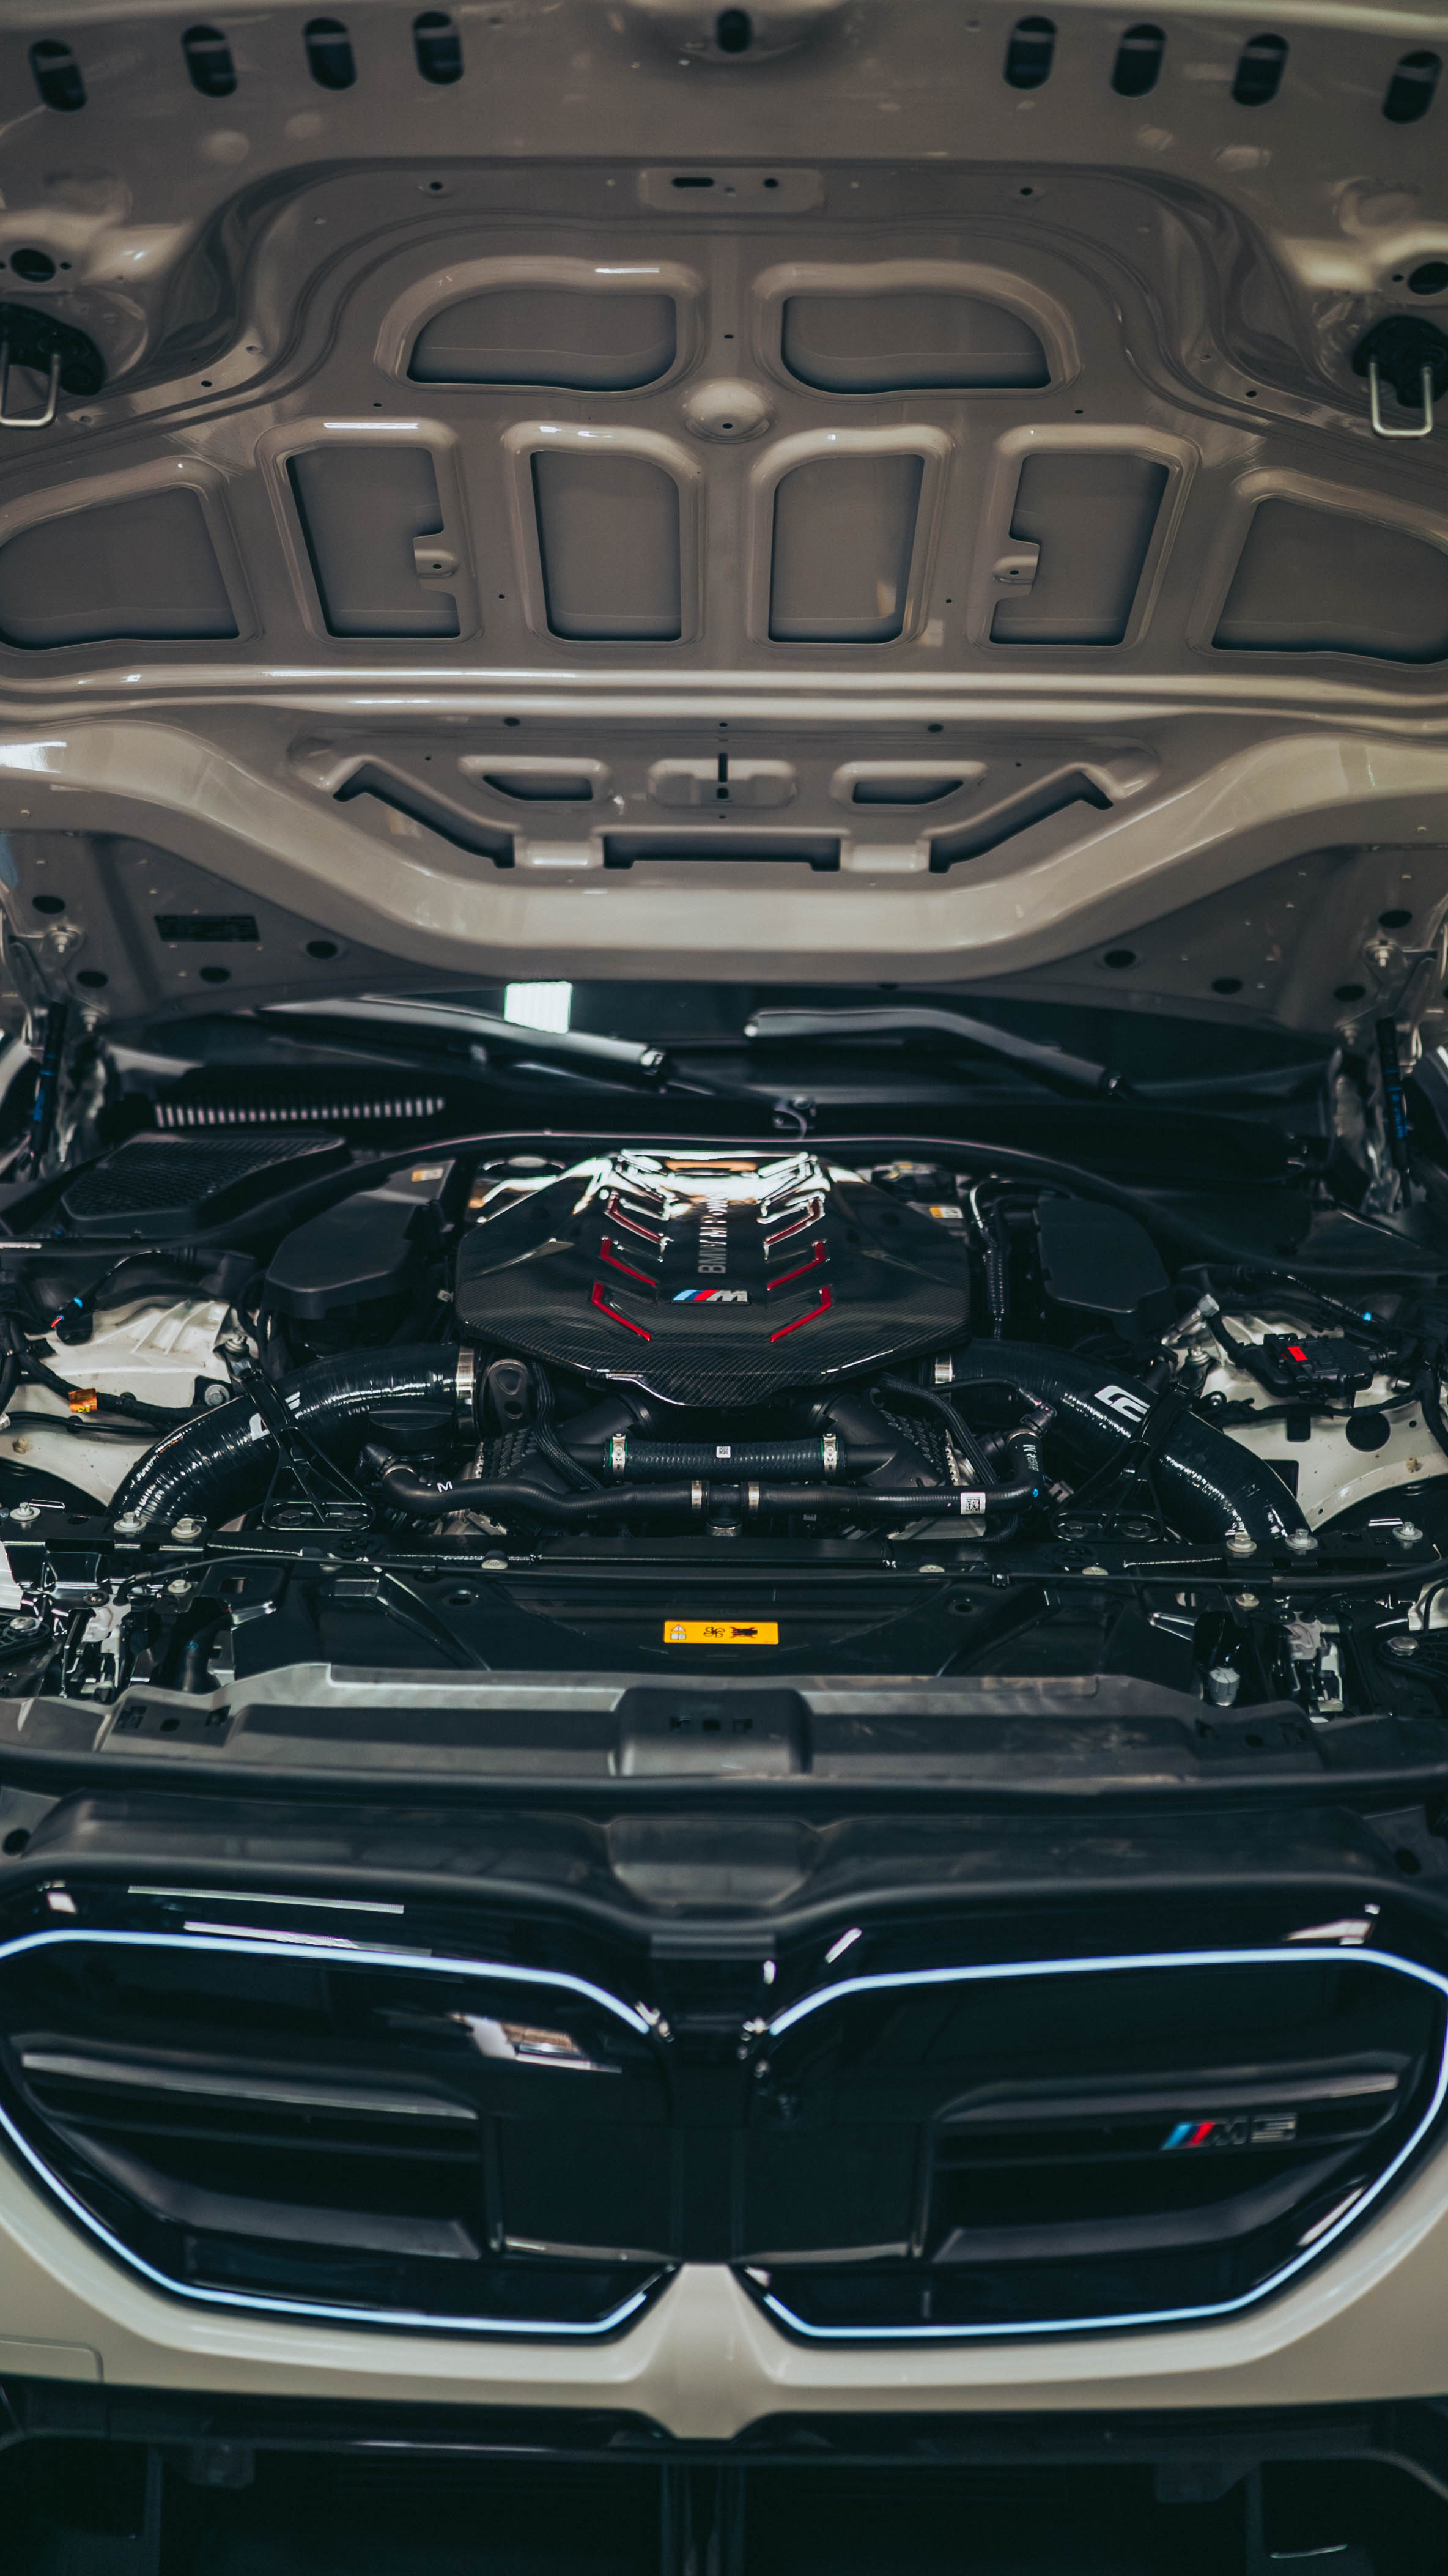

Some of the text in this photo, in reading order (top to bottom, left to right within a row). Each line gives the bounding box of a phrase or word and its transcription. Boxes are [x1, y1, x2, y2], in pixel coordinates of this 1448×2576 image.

[699, 1226, 728, 1237] M
[698, 1240, 728, 1274] BMW
[704, 1289, 748, 1303] M
[437, 1481, 453, 1493] M
[1203, 2112, 1297, 2147] M5
